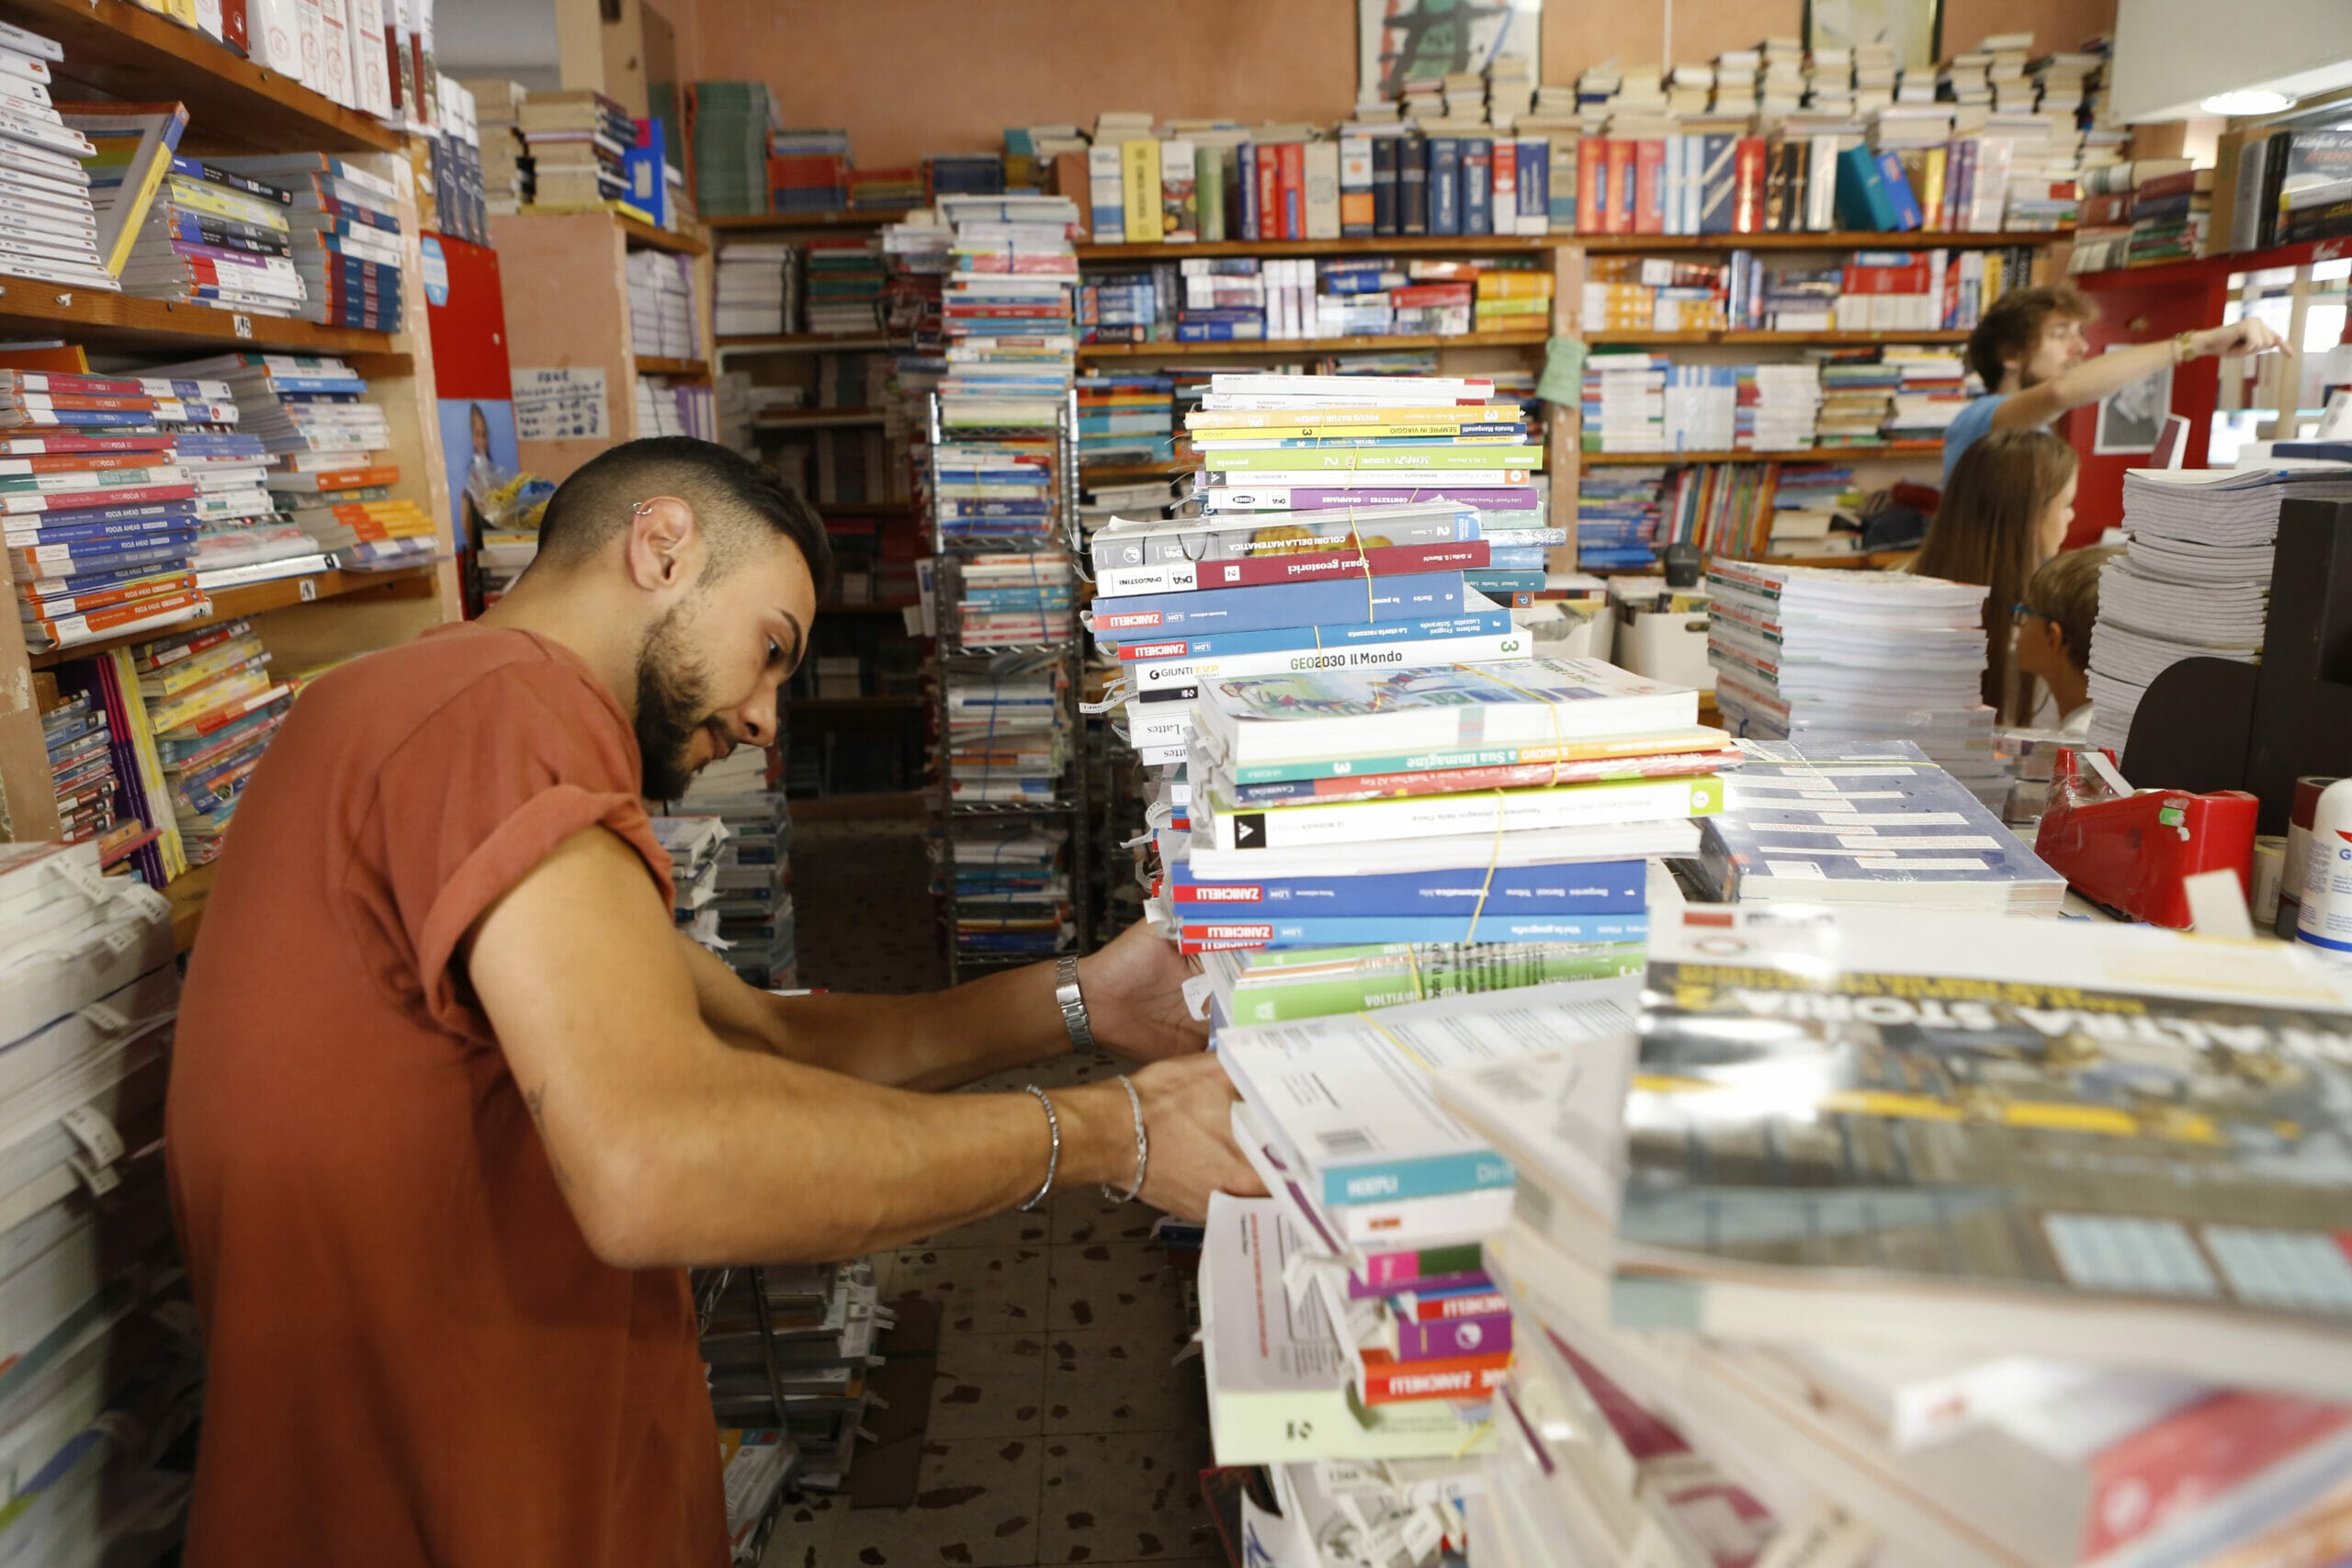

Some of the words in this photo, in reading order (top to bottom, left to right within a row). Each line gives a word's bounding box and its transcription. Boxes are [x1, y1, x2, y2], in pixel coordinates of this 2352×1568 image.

[1216, 458, 1250, 467] paravia
[1324, 457, 1339, 467] 2
[1436, 525, 1451, 536] 2
[1228, 538, 1288, 553] MATEMATICA
[1290, 537, 1313, 546] DELLA
[1314, 535, 1346, 545] COLORI
[1288, 559, 1339, 575] geostorici
[1341, 557, 1370, 570] Spazi
[1110, 614, 1159, 626] ZANICHELLI
[1453, 618, 1480, 626] Luzzatto
[1348, 629, 1377, 638] racconta
[1430, 626, 1453, 635] Frugoni
[1136, 644, 1185, 657] ZANICHELLI
[1193, 643, 1210, 651] LDM
[1161, 667, 1193, 677] GIUNTI
[1290, 655, 1345, 671] GEO2030
[1351, 654, 1358, 665] Il
[1361, 650, 1402, 664] Mondo
[1500, 640, 1520, 652] 3
[1147, 724, 1180, 735] Lattes
[1164, 749, 1187, 757] attes
[1480, 752, 1506, 763] Sua
[1407, 754, 1476, 768] immagine
[1361, 778, 1376, 786] Key
[1196, 887, 1259, 900] ZANICHELLI
[1207, 927, 1270, 938] ZANICHELLI
[1389, 1371, 1472, 1394] ZANICHELLI
